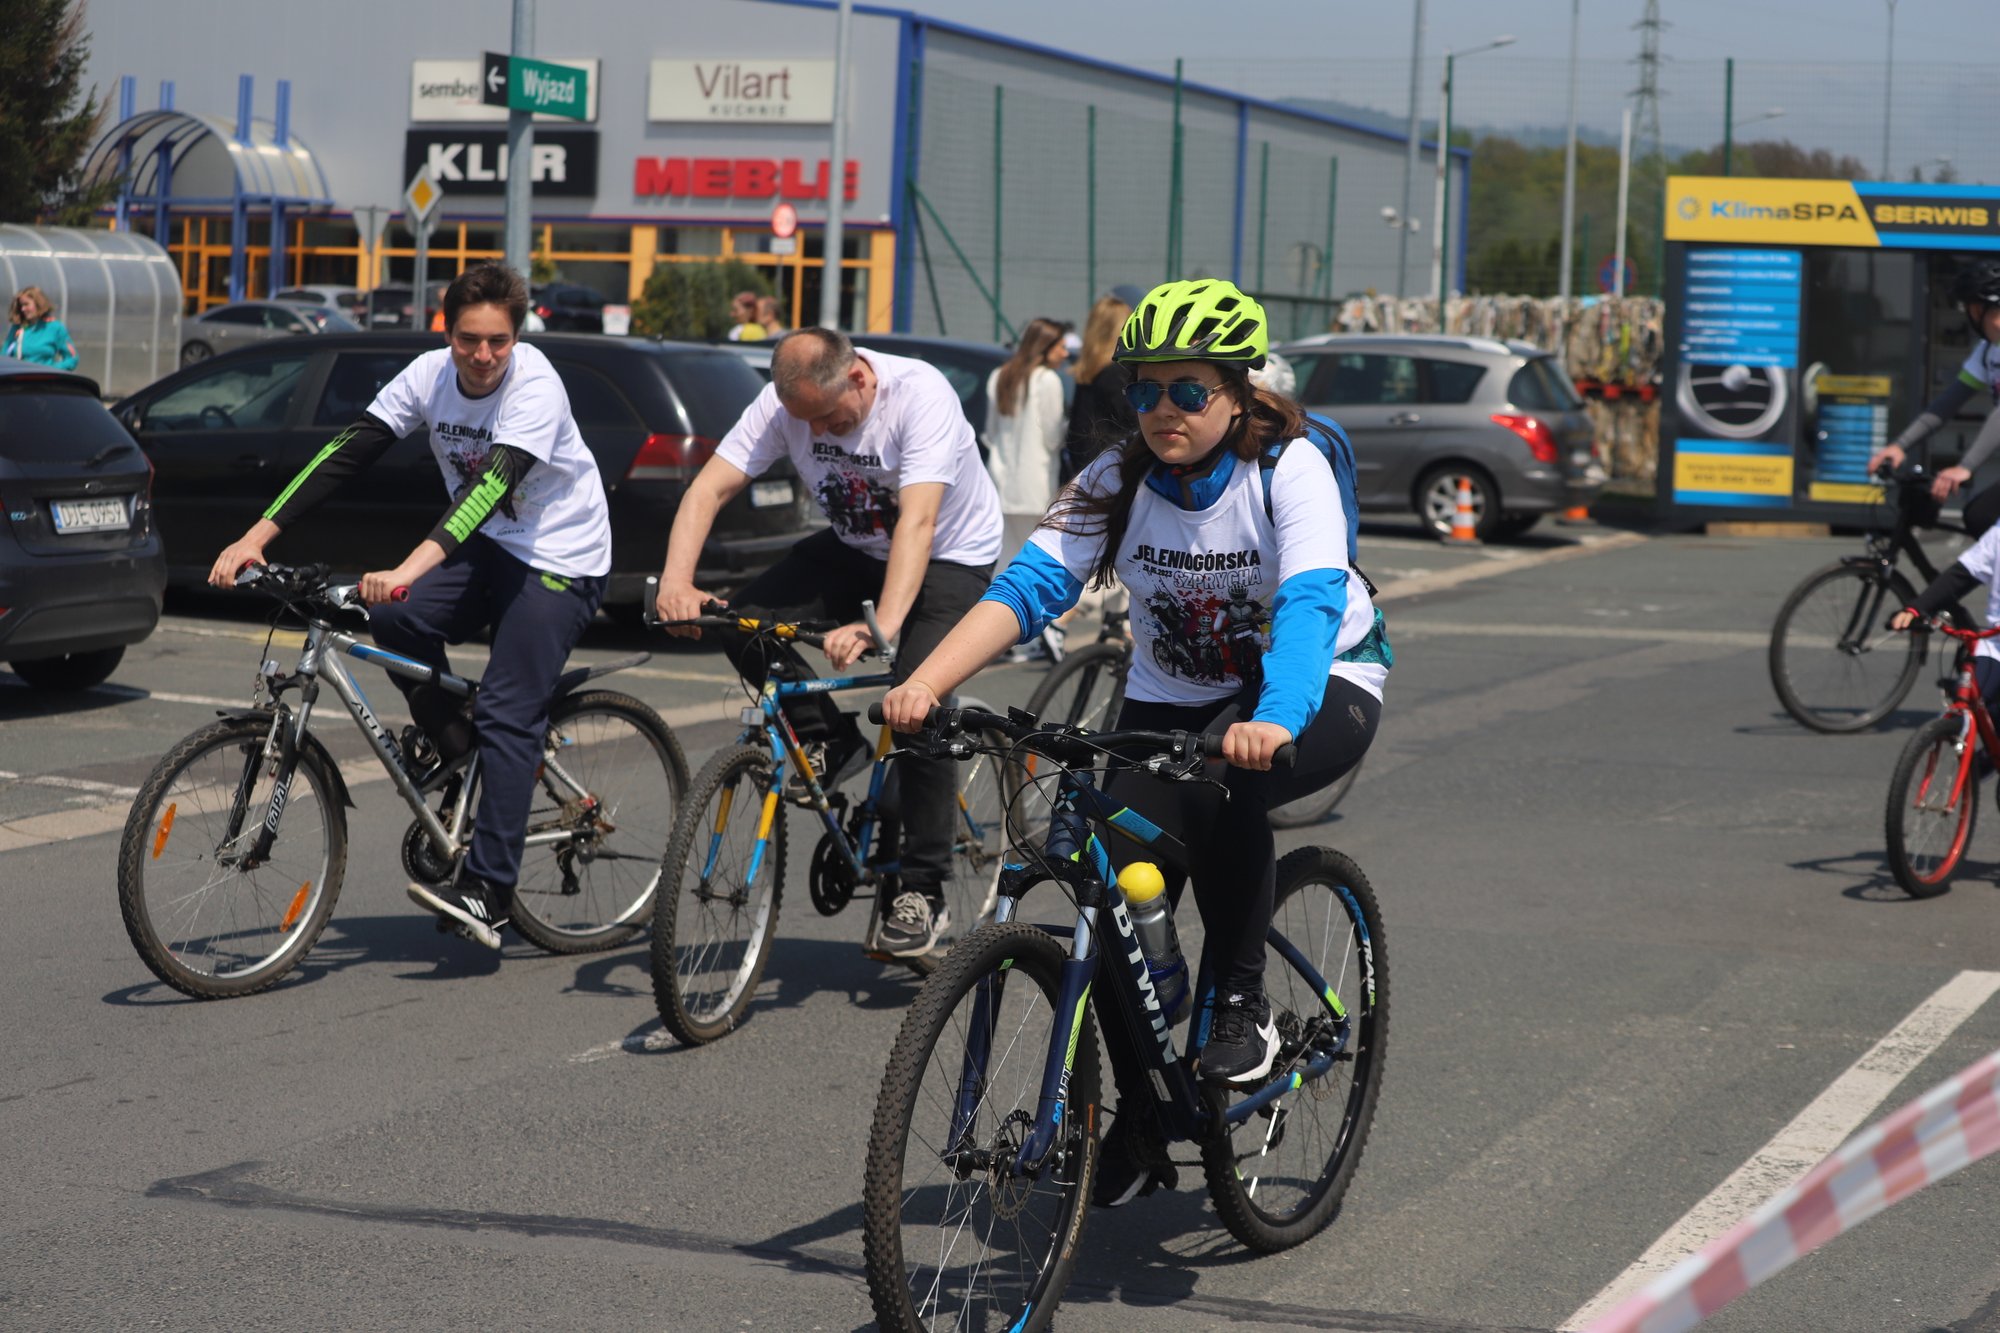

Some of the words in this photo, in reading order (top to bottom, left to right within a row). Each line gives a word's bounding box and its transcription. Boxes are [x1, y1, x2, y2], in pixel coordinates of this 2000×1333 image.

[419, 78, 479, 98] sembe
[522, 66, 576, 106] Wyjazd
[695, 63, 790, 100] Vilart
[709, 104, 787, 116] KUCHNIE
[634, 156, 860, 201] MEBLE
[1711, 201, 1858, 221] KlimaSPA
[1874, 204, 1990, 227] SERWIS
[443, 470, 508, 543] PUMA
[1133, 544, 1261, 572] JELENIOGÓRSKA
[1173, 567, 1263, 589] SZPRYCHA
